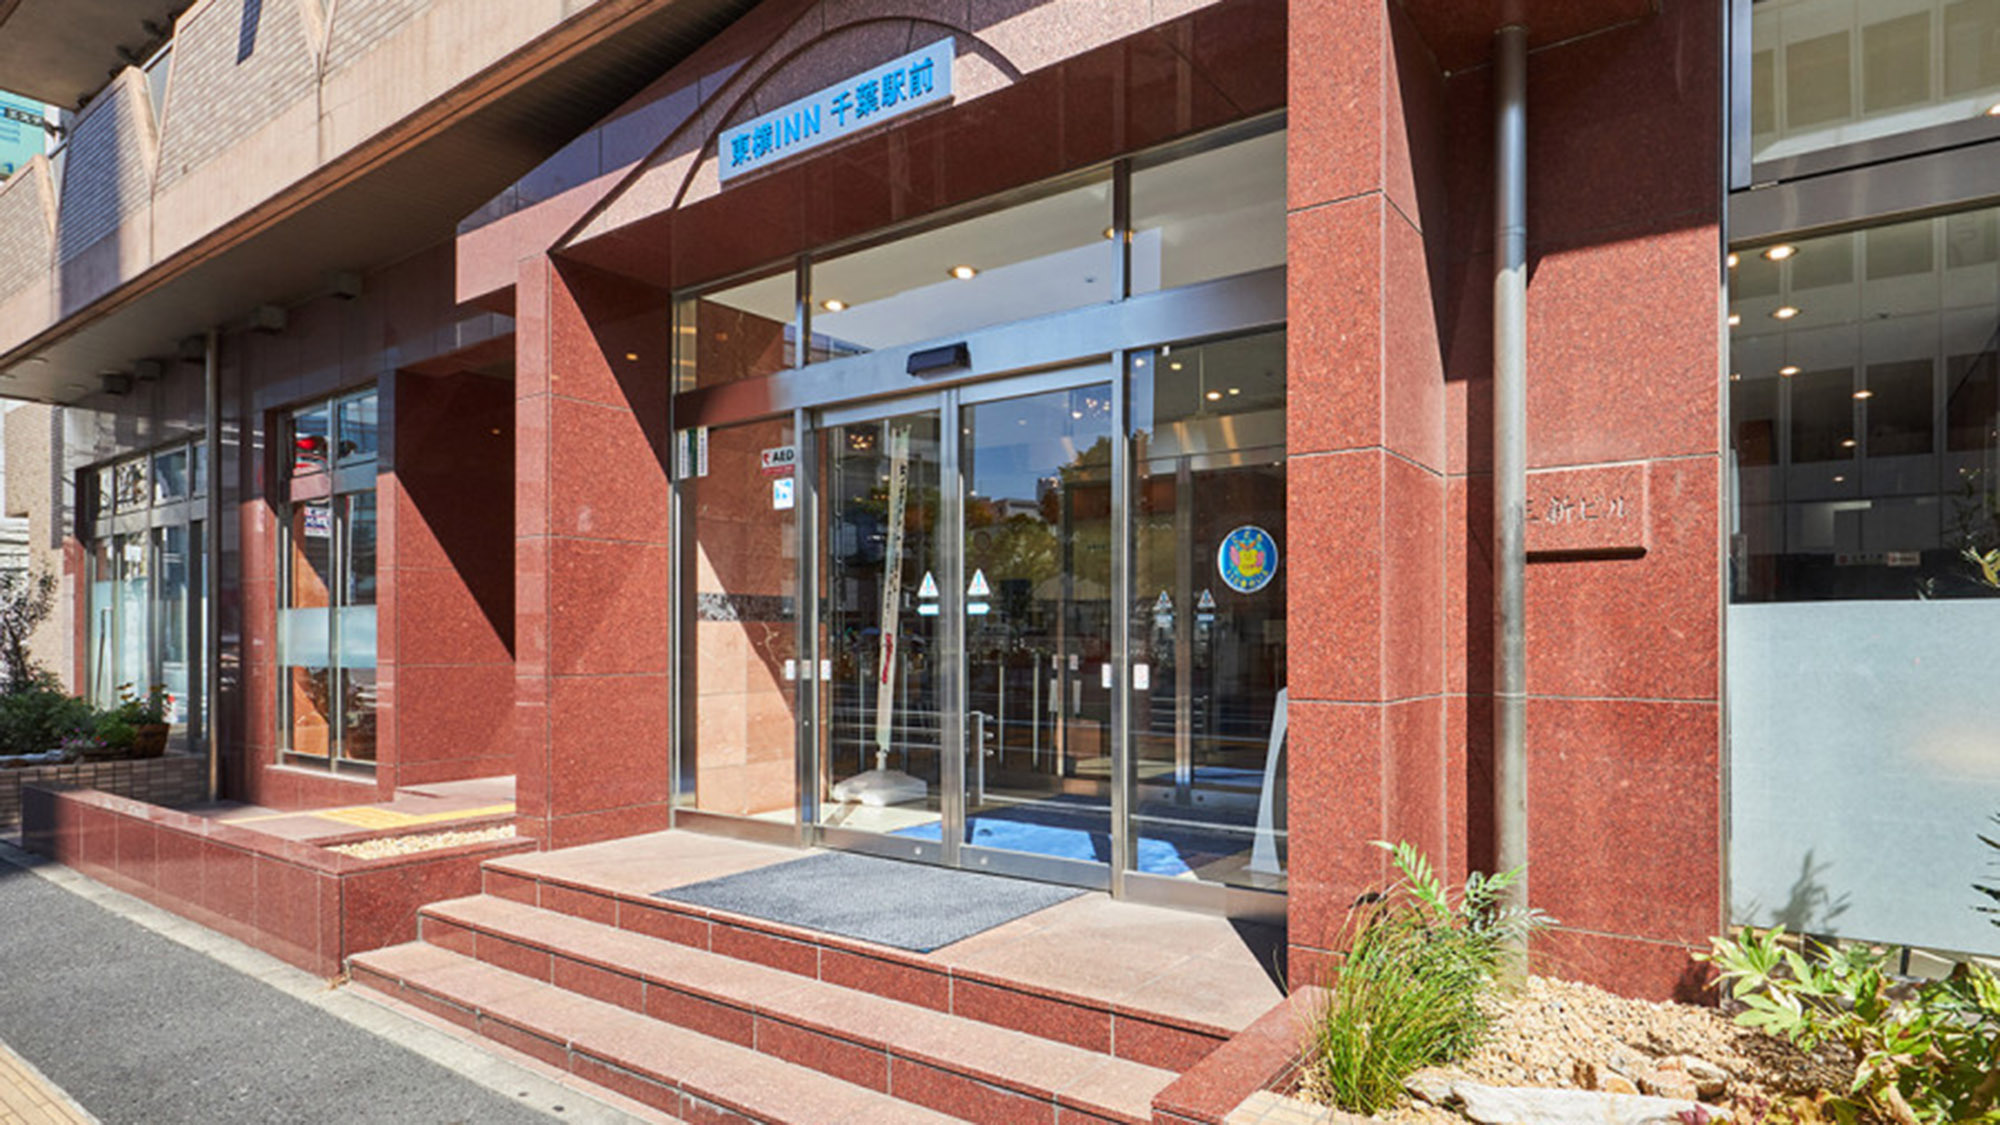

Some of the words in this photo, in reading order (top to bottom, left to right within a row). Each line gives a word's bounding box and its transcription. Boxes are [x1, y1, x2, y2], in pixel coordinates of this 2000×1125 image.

[730, 104, 821, 167] 東横INN
[830, 57, 934, 127] 千葉駅前
[772, 449, 795, 463] AED
